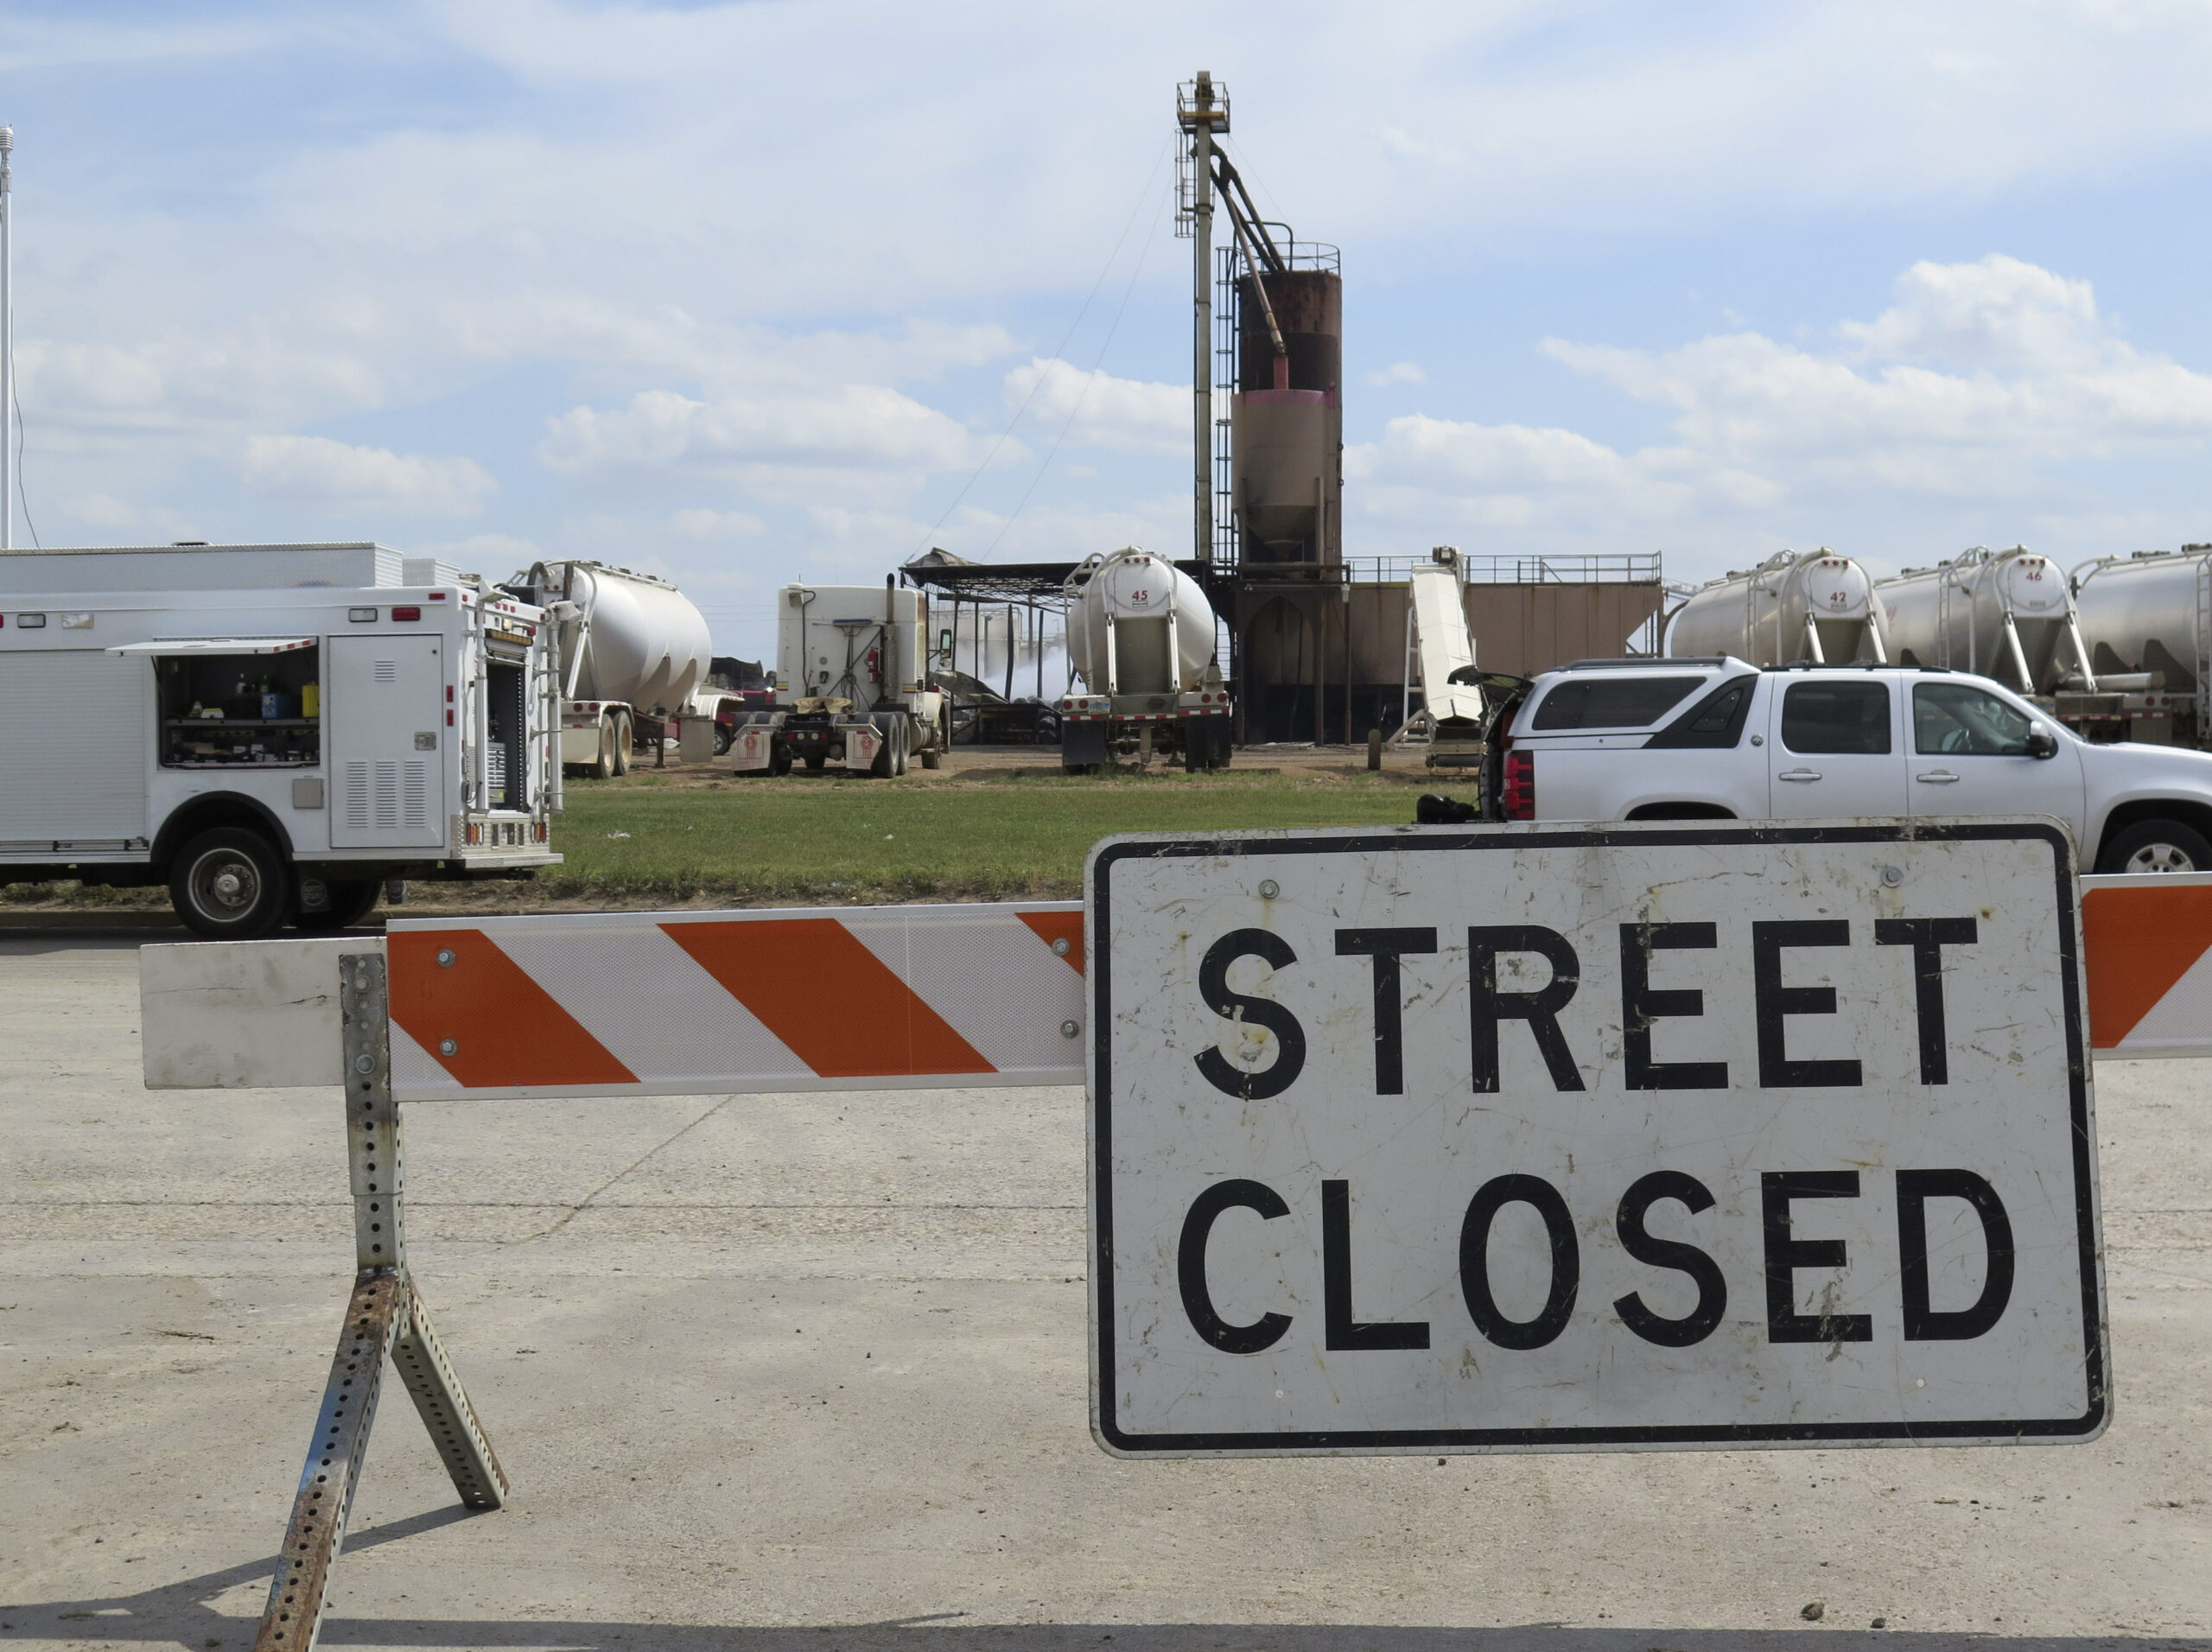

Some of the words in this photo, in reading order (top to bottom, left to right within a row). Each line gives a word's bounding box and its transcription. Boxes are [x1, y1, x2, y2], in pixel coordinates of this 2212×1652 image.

[2025, 571, 2043, 581] 46
[1132, 590, 1148, 600] 45
[1830, 592, 1847, 602] 42
[1193, 918, 1978, 1102] STREET
[1177, 1169, 2015, 1355] CLOSED
